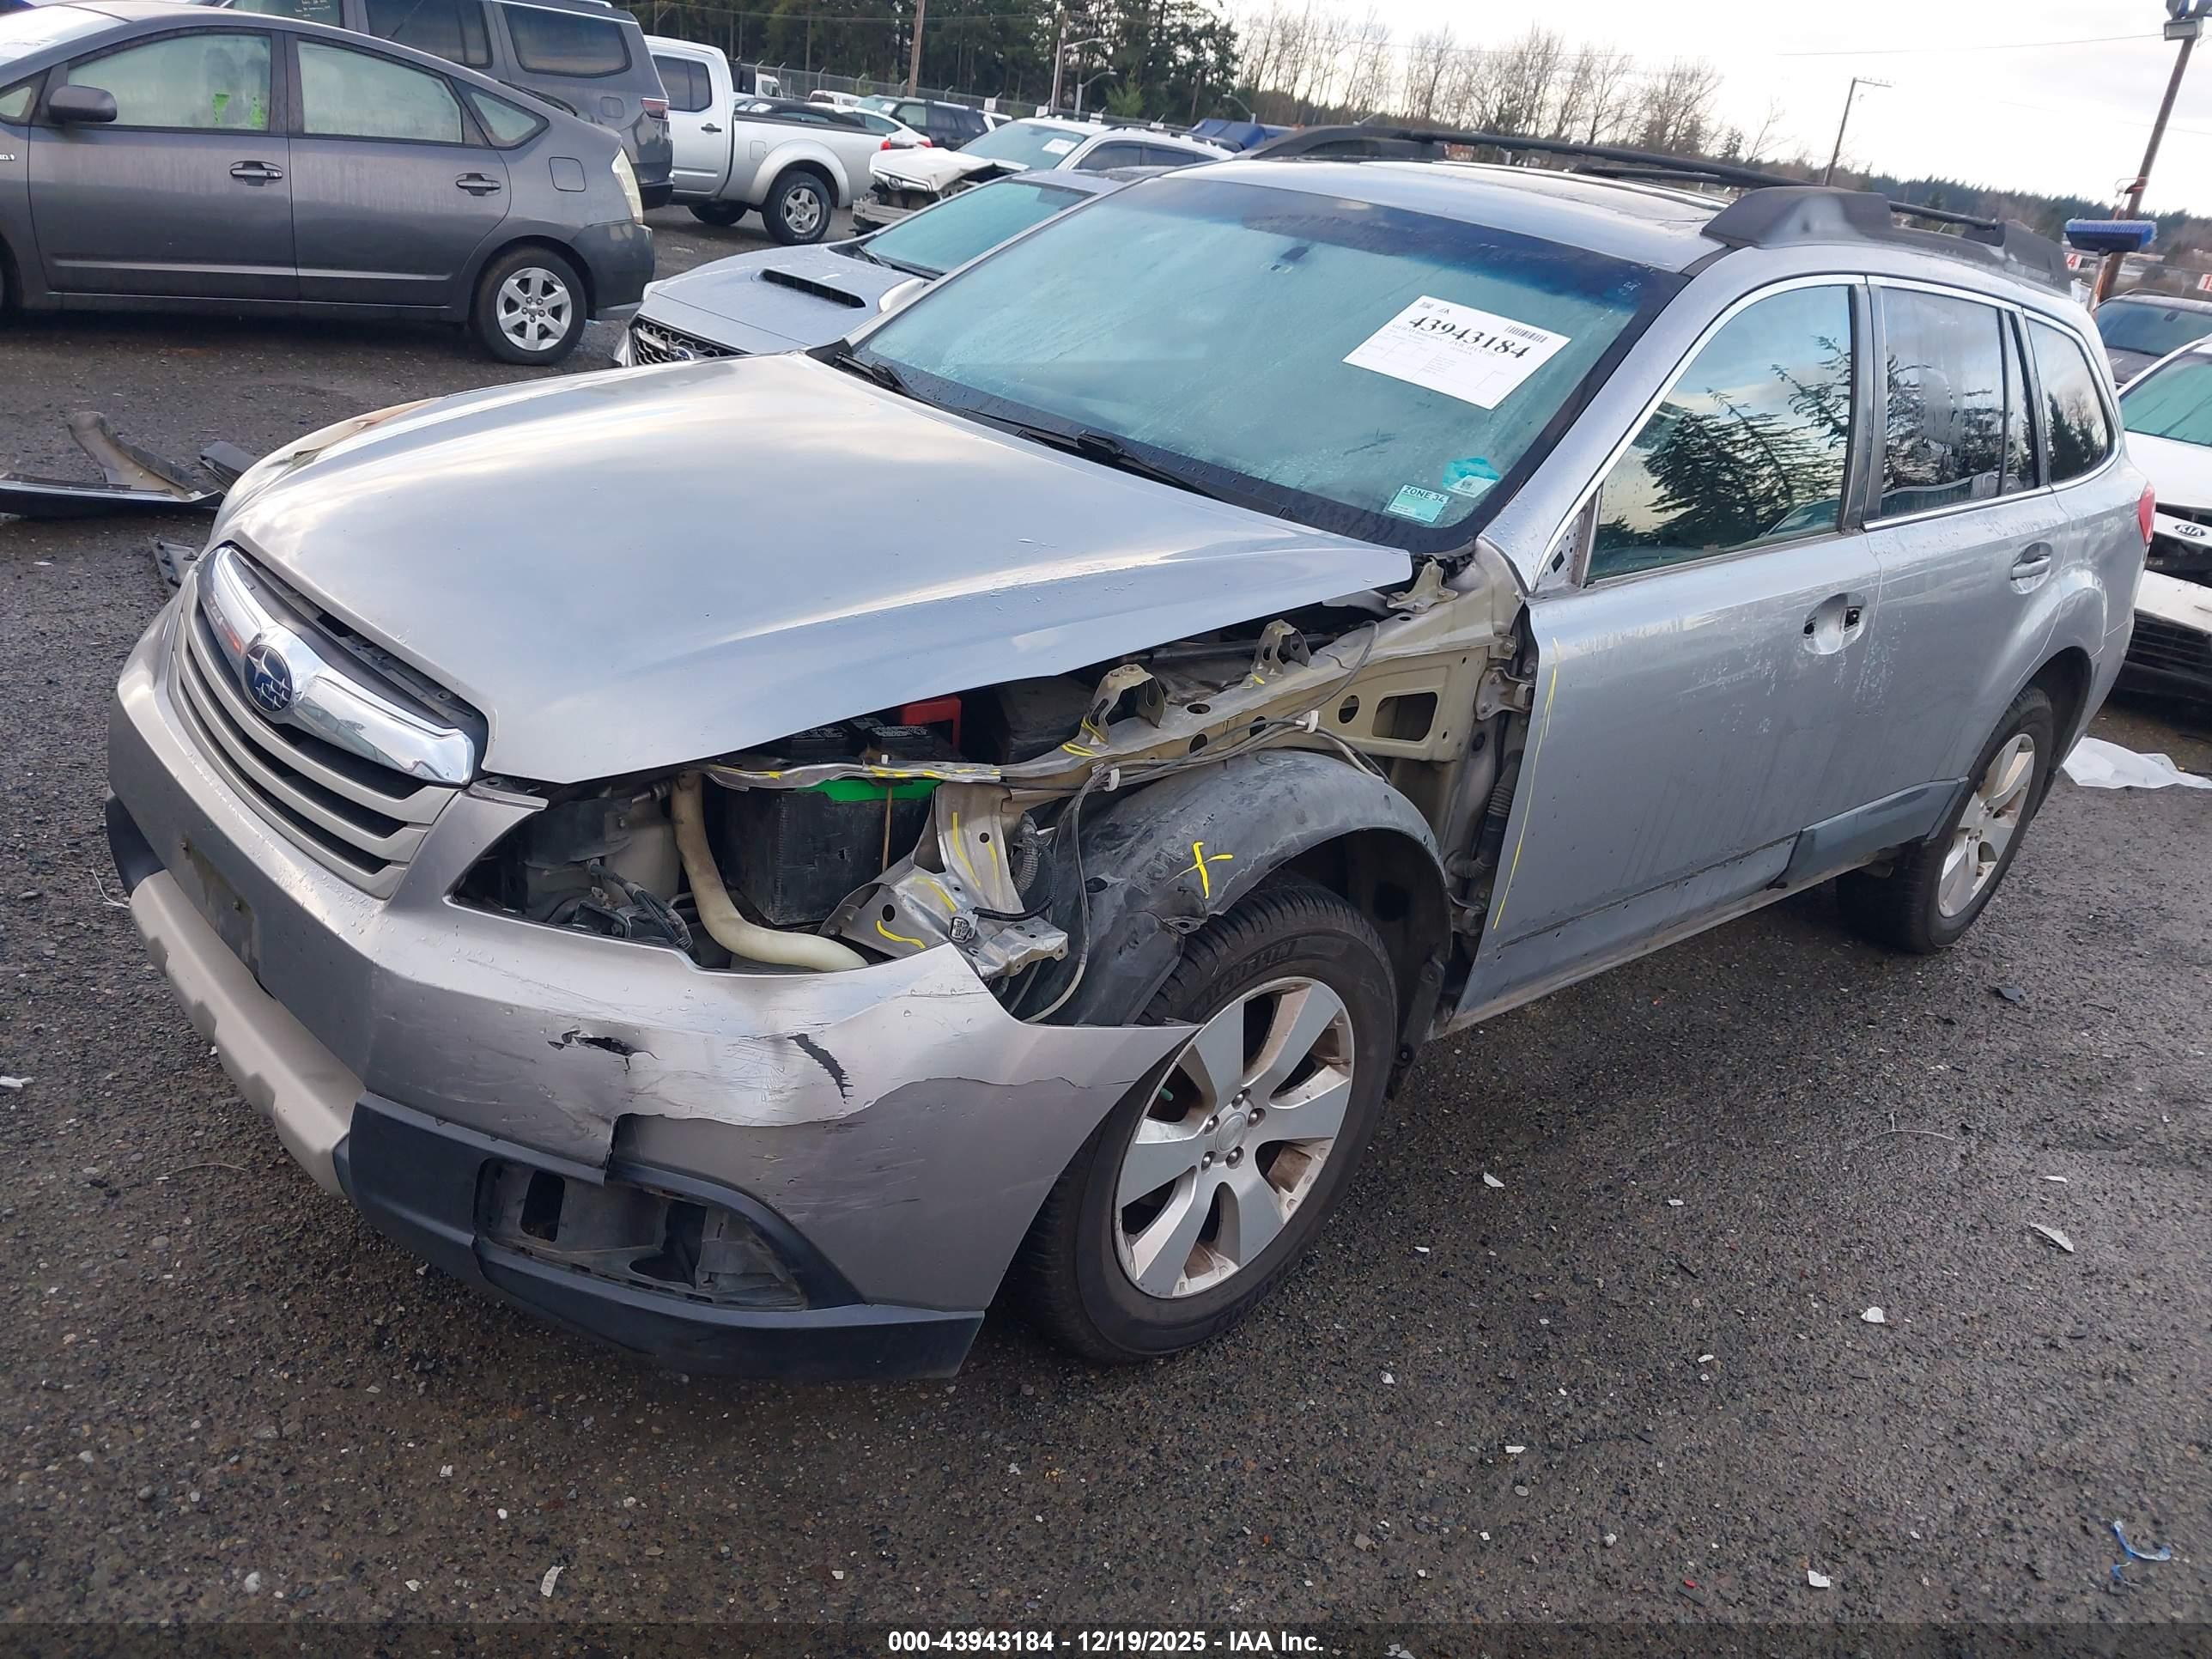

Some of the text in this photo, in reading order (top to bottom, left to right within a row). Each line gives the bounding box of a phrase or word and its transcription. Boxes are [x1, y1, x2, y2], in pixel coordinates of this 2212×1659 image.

[1409, 315, 1532, 359] 43943184
[1403, 486, 1431, 499] ZONE
[2178, 526, 2202, 536] KIA
